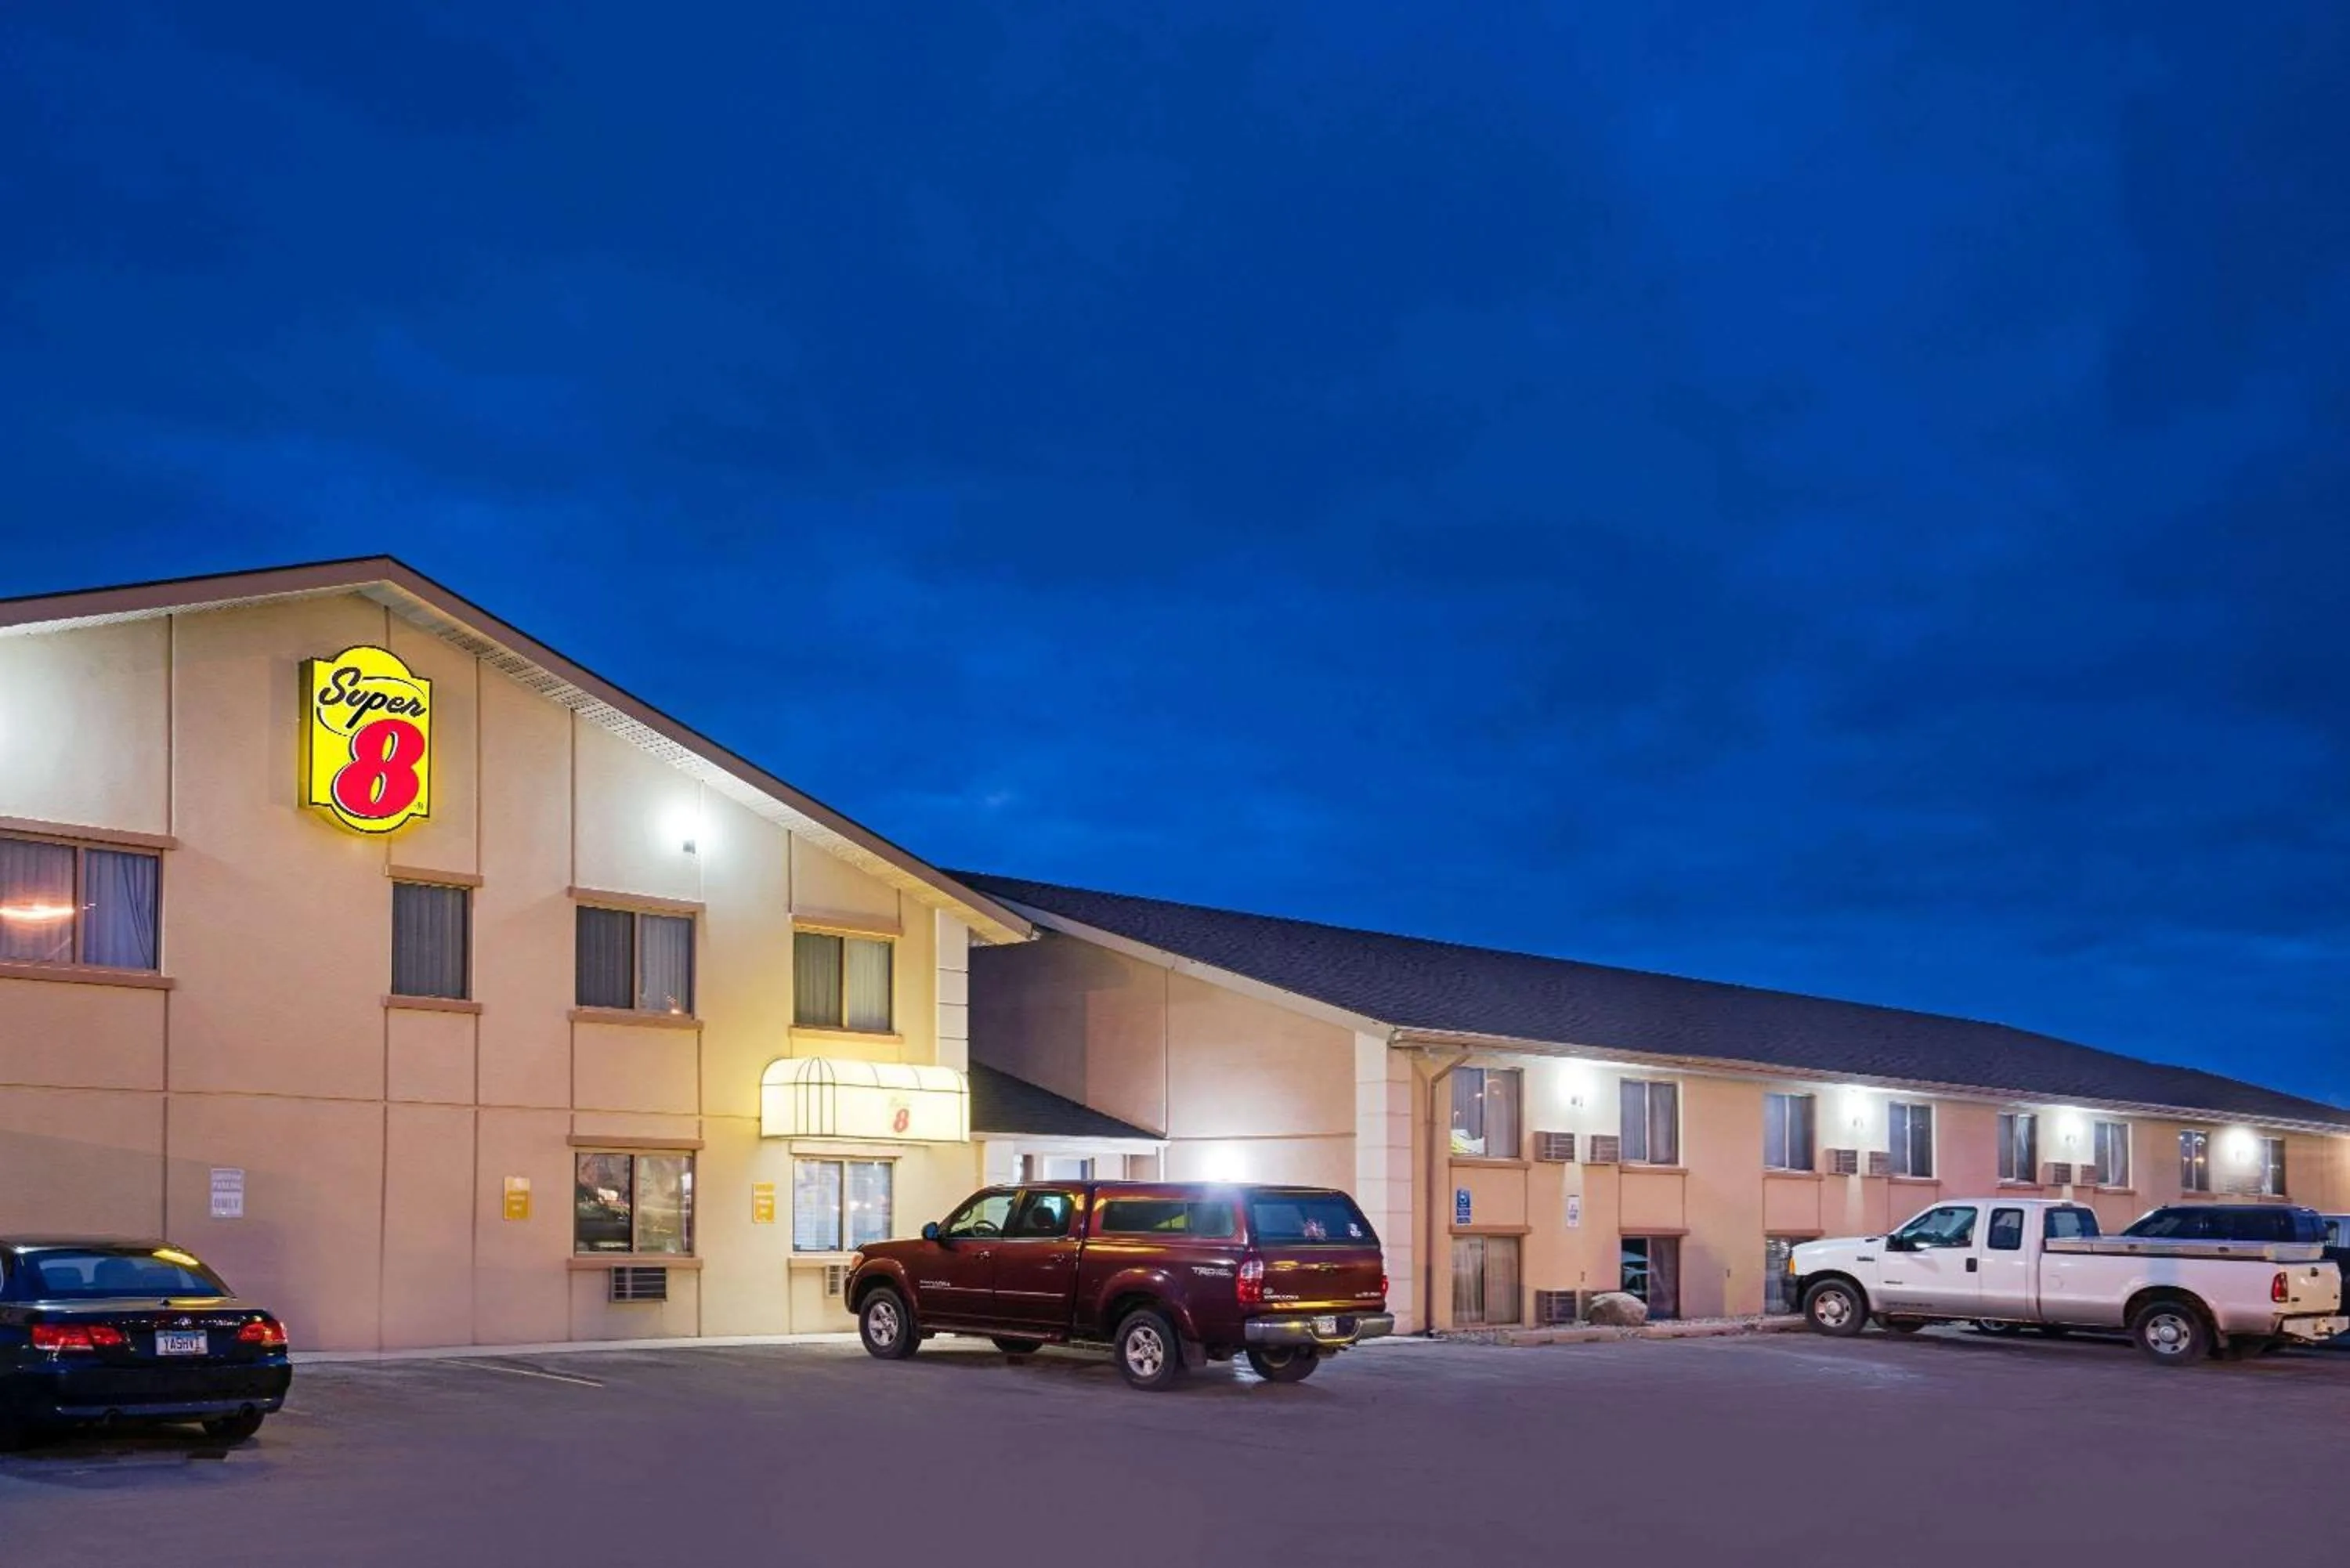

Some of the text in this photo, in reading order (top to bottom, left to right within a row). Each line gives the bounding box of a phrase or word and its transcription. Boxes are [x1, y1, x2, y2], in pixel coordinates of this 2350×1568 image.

[318, 667, 426, 729] Super
[331, 718, 425, 819] 8
[893, 1108, 909, 1133] 8
